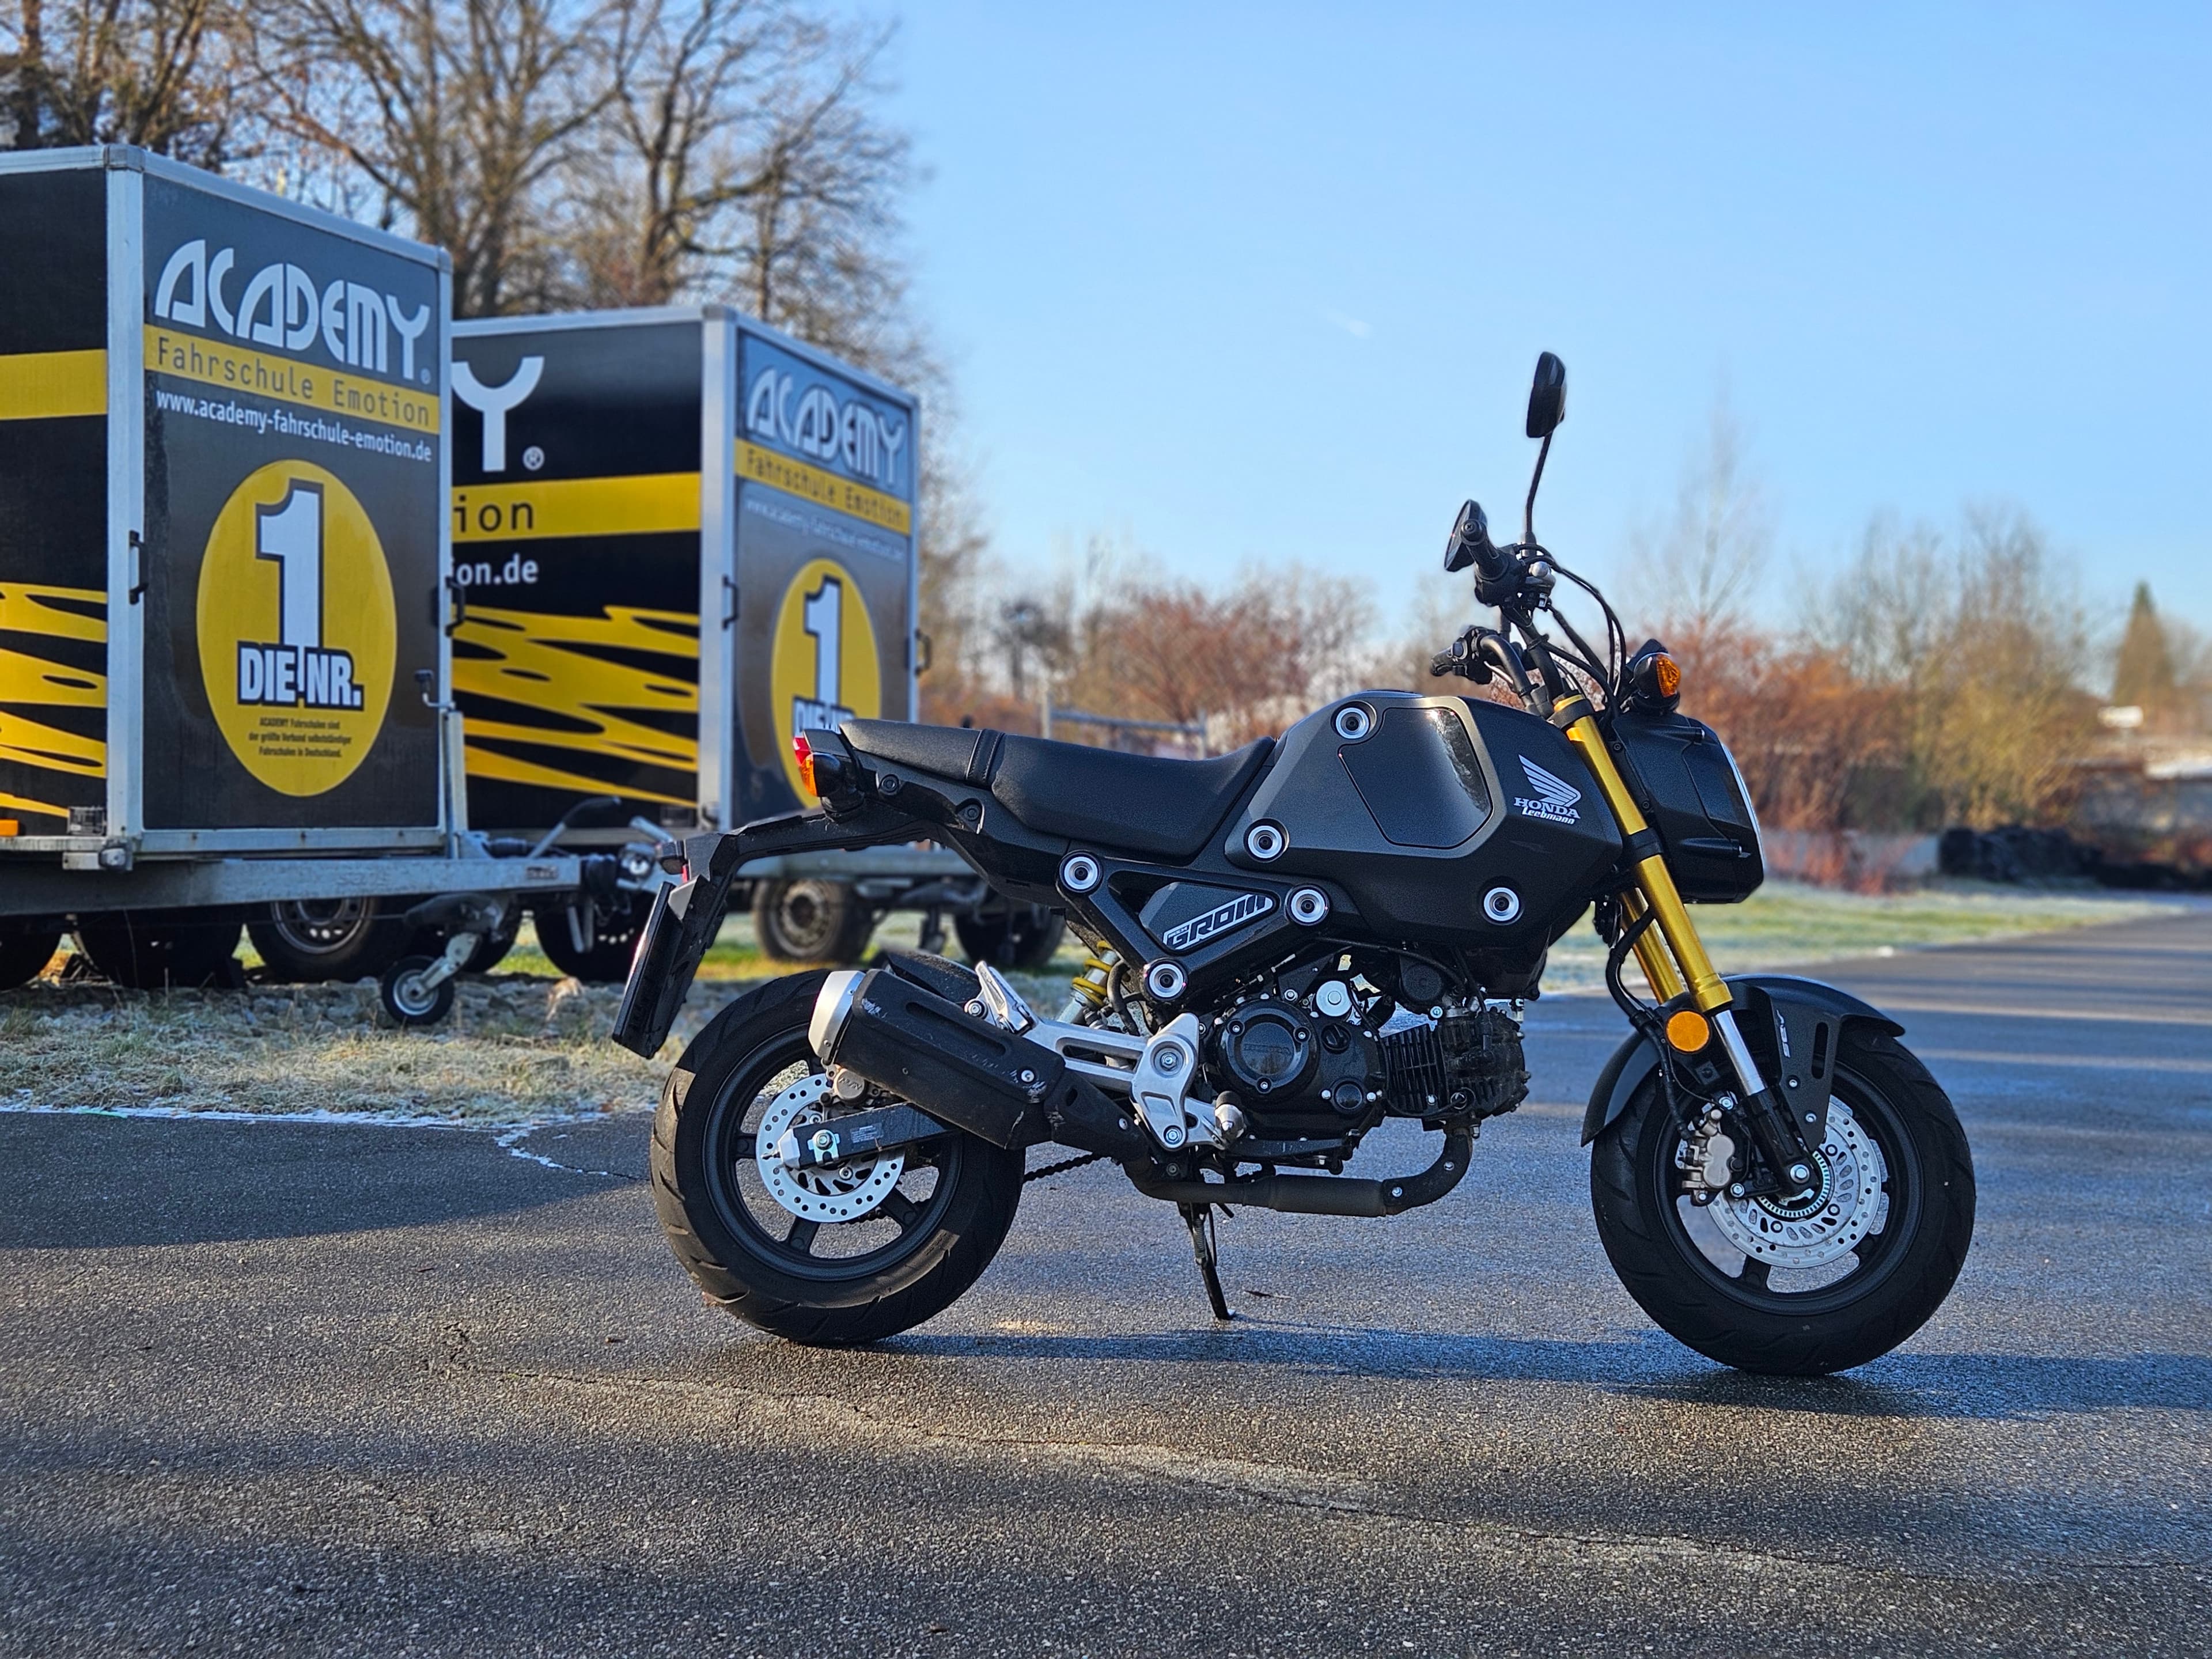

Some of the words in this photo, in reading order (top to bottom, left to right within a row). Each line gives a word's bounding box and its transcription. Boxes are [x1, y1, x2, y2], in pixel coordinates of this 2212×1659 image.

[154, 239, 431, 380] ACADEMY
[158, 336, 314, 400] Fahrschule
[334, 379, 429, 427] Emotion
[156, 389, 432, 462] www.academy-fahrschule-emotion.de
[747, 368, 903, 484] ACADEMY
[452, 552, 539, 586] on.de
[239, 646, 296, 704] DIE
[306, 652, 362, 707] NR.
[1513, 797, 1581, 820] HONDA
[1521, 807, 1575, 825] Leebmann
[1165, 895, 1267, 949] GROM
